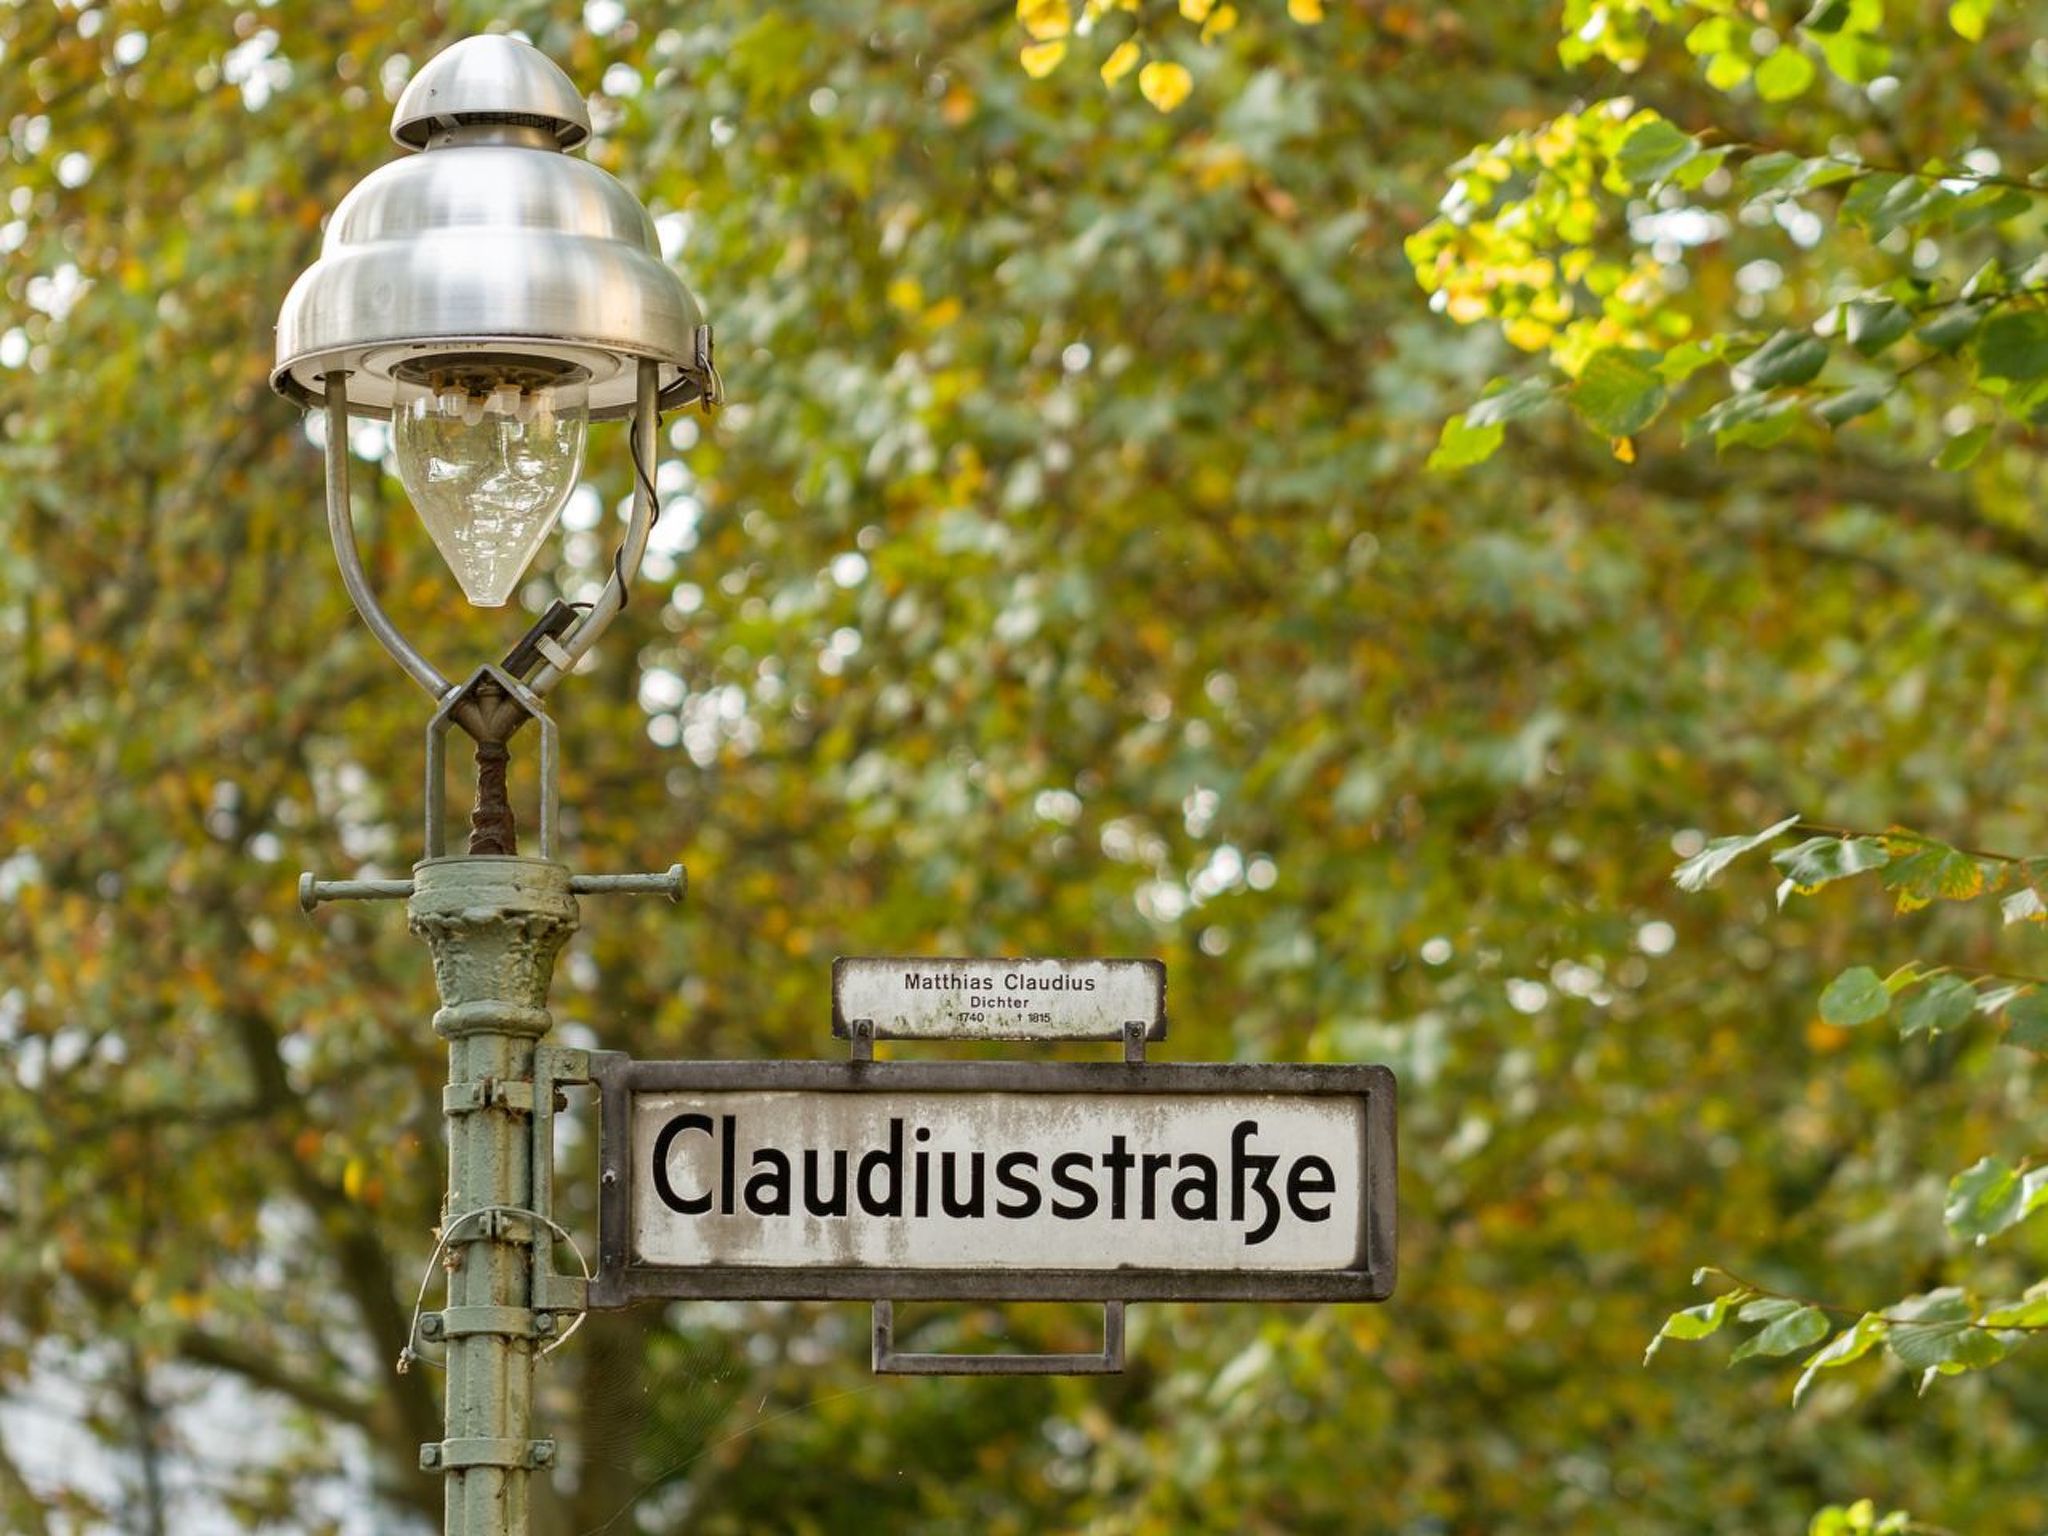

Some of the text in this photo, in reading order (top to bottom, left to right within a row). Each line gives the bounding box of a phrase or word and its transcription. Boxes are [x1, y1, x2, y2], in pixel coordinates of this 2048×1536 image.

[905, 973, 1096, 991] Matthias Claudius
[970, 996, 1030, 1009] Dichter
[957, 1012, 984, 1023] 1740
[1028, 1013, 1051, 1023] 1815
[652, 1113, 1337, 1246] Claudiusstraße
